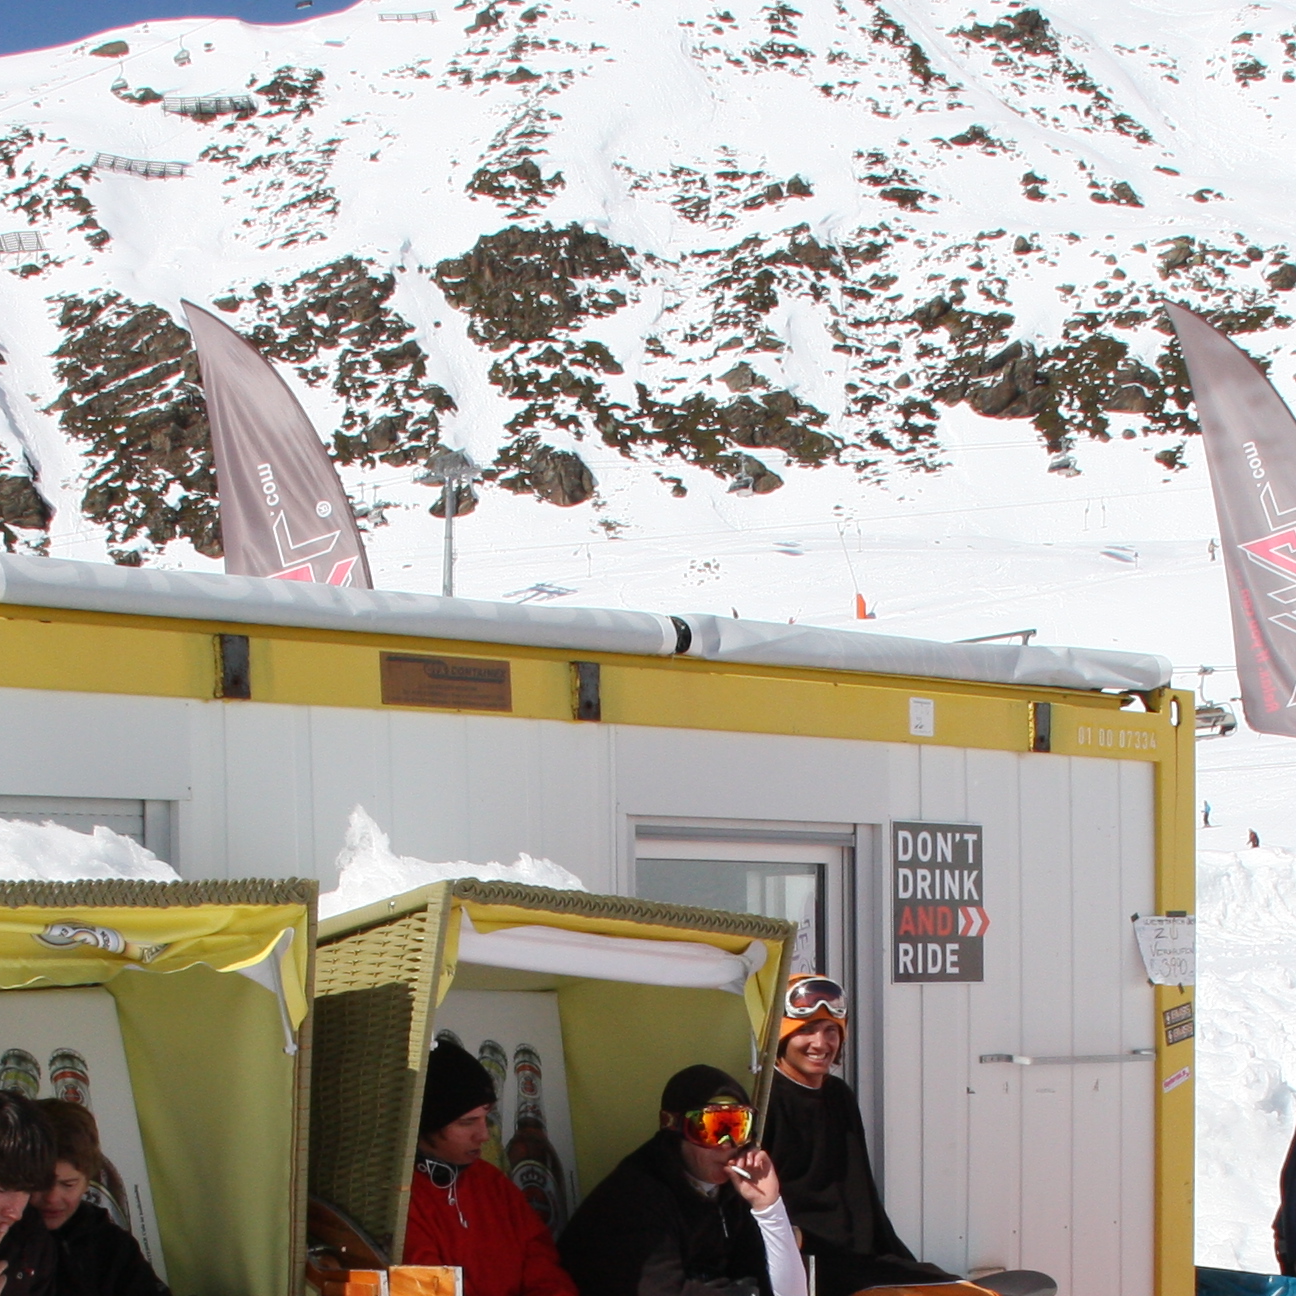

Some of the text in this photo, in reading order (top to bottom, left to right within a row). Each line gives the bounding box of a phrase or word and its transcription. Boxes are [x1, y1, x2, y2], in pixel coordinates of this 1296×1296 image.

[898, 831, 978, 864] DON'T
[898, 869, 979, 901] DRINK
[899, 905, 954, 937] AND
[899, 943, 960, 975] RIDE
